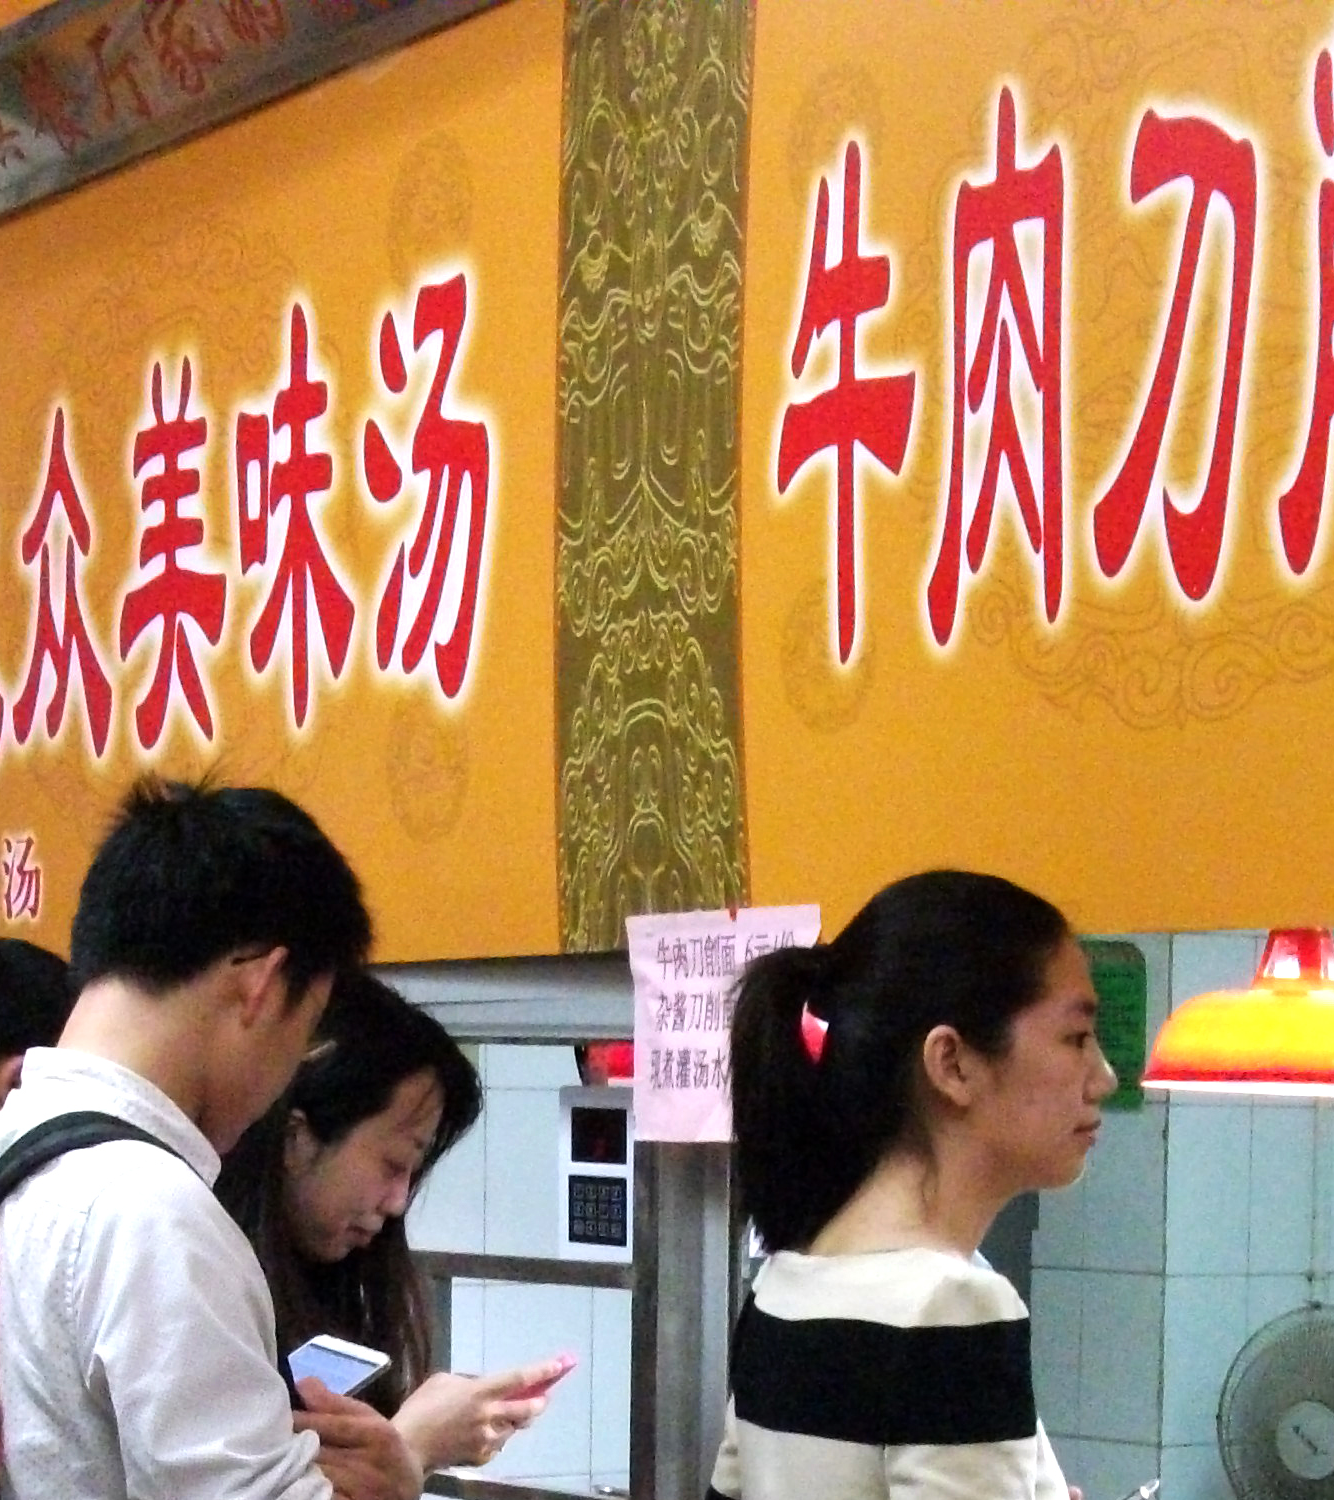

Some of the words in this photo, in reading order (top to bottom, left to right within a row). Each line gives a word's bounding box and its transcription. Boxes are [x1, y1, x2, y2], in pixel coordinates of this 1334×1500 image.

[657, 934, 737, 980] 牛肉刀削面
